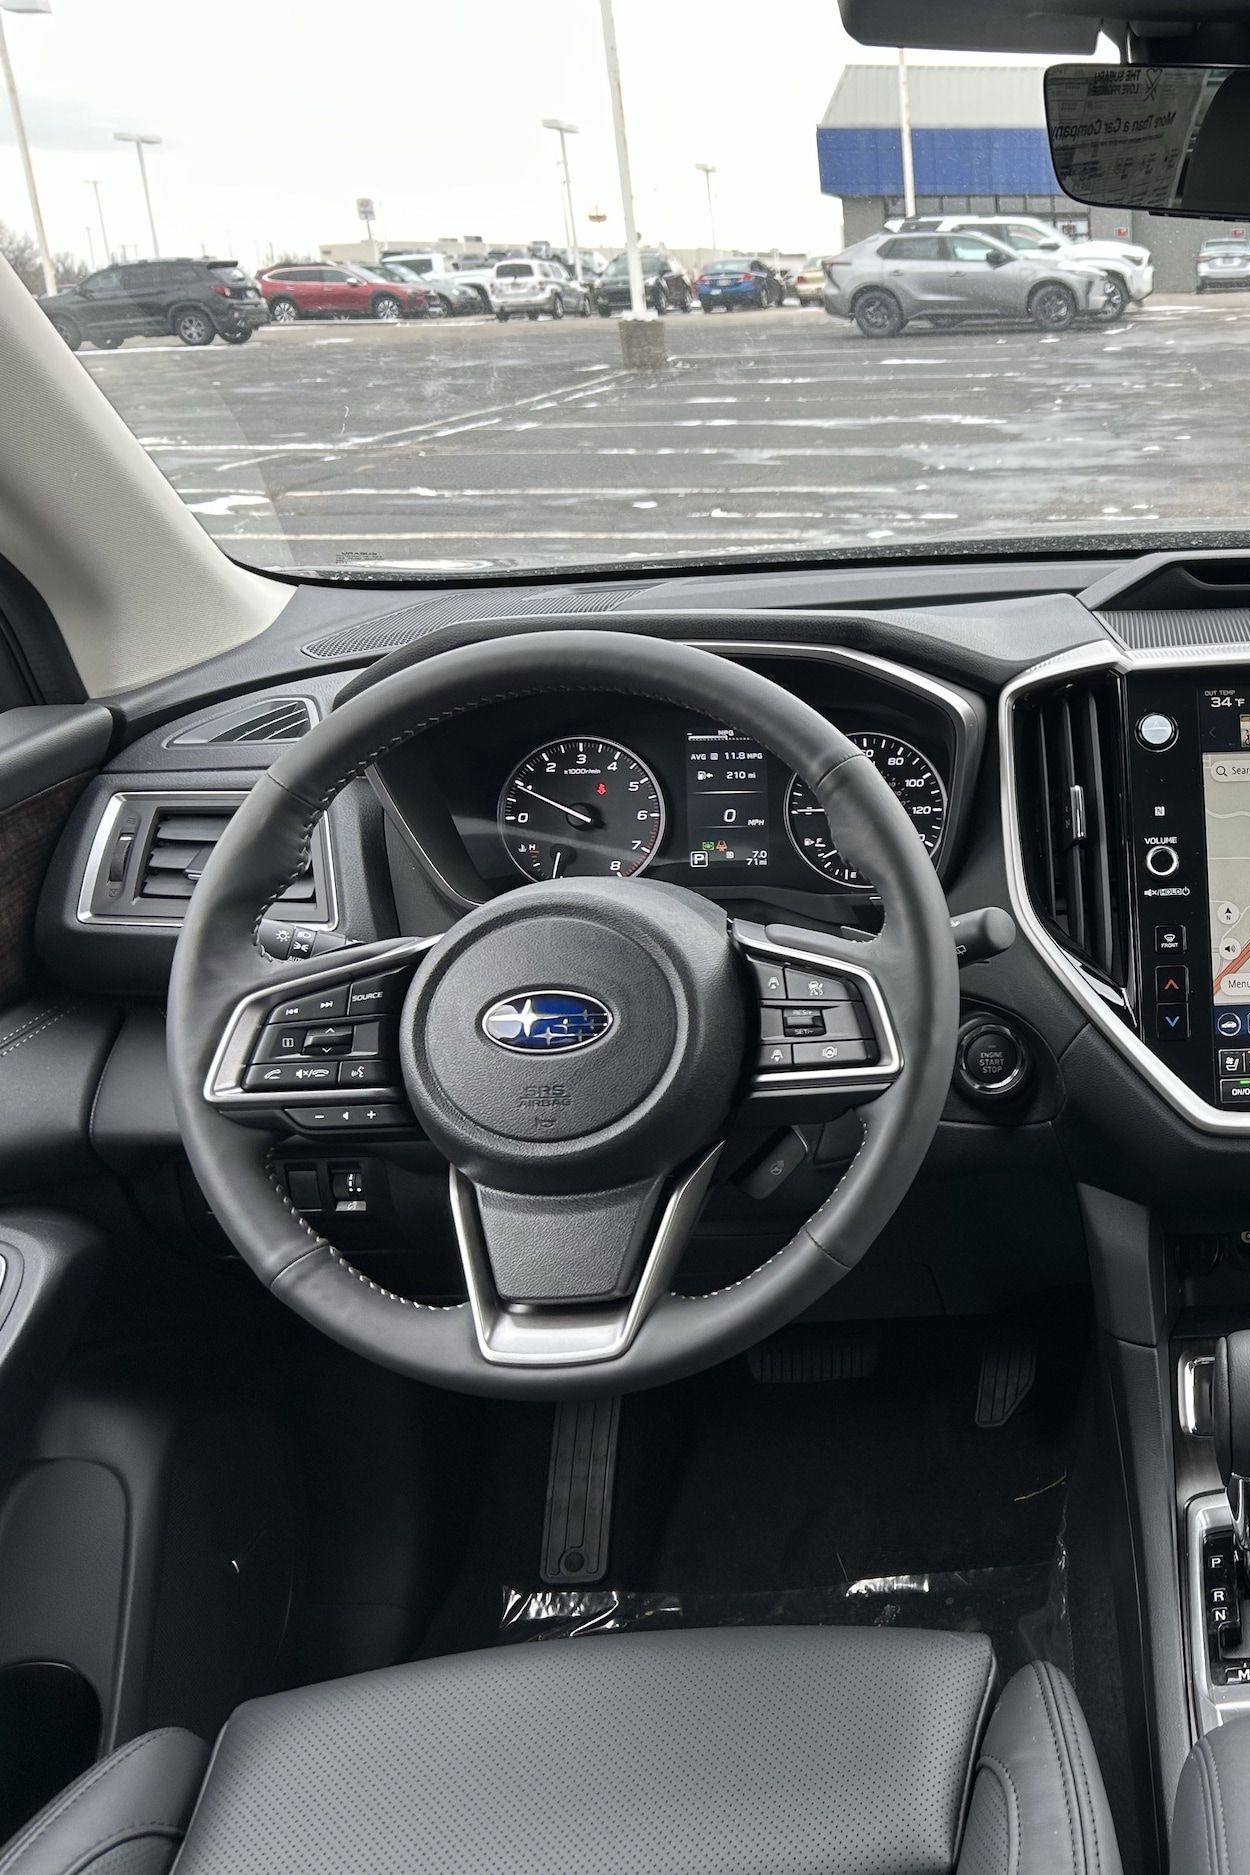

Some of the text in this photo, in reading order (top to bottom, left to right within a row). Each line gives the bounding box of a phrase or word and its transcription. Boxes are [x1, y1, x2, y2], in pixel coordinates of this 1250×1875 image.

[1210, 697, 1232, 708] 34
[576, 754, 587, 764] 3
[725, 752, 746, 760] 11.8
[747, 752, 763, 760] MPG
[887, 757, 904, 765] 80
[546, 762, 557, 773] 2
[607, 761, 618, 771] 4
[726, 771, 746, 779] 210
[628, 782, 639, 791] 5
[905, 779, 925, 787] 100
[637, 810, 648, 820] 6
[723, 808, 737, 822] 0
[912, 806, 931, 814] 120
[518, 813, 529, 823] 0
[632, 840, 642, 850] 7
[1144, 837, 1178, 845] VOLUME
[693, 854, 705, 864] P
[752, 850, 767, 858] 7.0
[610, 861, 621, 871] 8
[352, 991, 384, 1002] SOURCE
[979, 1058, 1004, 1066] START
[982, 1066, 1003, 1074] STOP
[526, 1085, 565, 1096] SRS
[519, 1098, 571, 1107] AIRBAG
[1211, 1557, 1221, 1568] P
[1213, 1590, 1225, 1602] R
[1214, 1609, 1226, 1621] N
